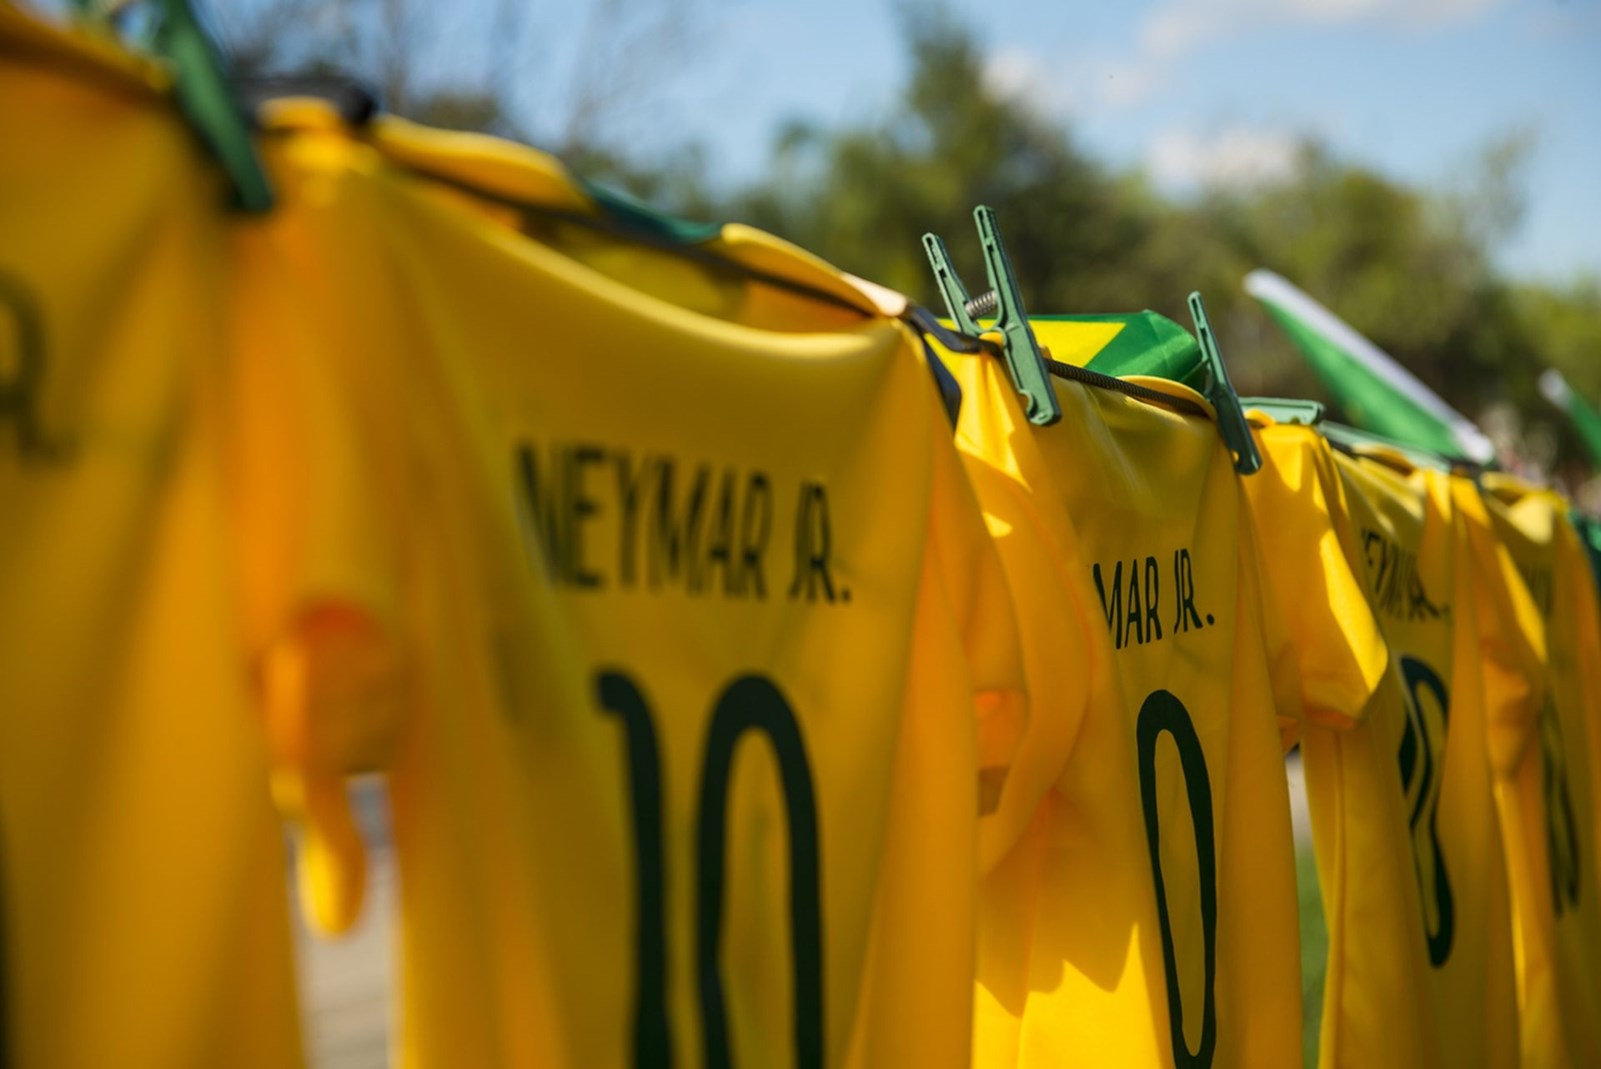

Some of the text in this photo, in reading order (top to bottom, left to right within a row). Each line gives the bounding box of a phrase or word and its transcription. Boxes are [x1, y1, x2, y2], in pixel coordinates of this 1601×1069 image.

[515, 440, 770, 600] NEYMAR
[1174, 548, 1216, 635] JR.
[595, 667, 824, 1069] 10
